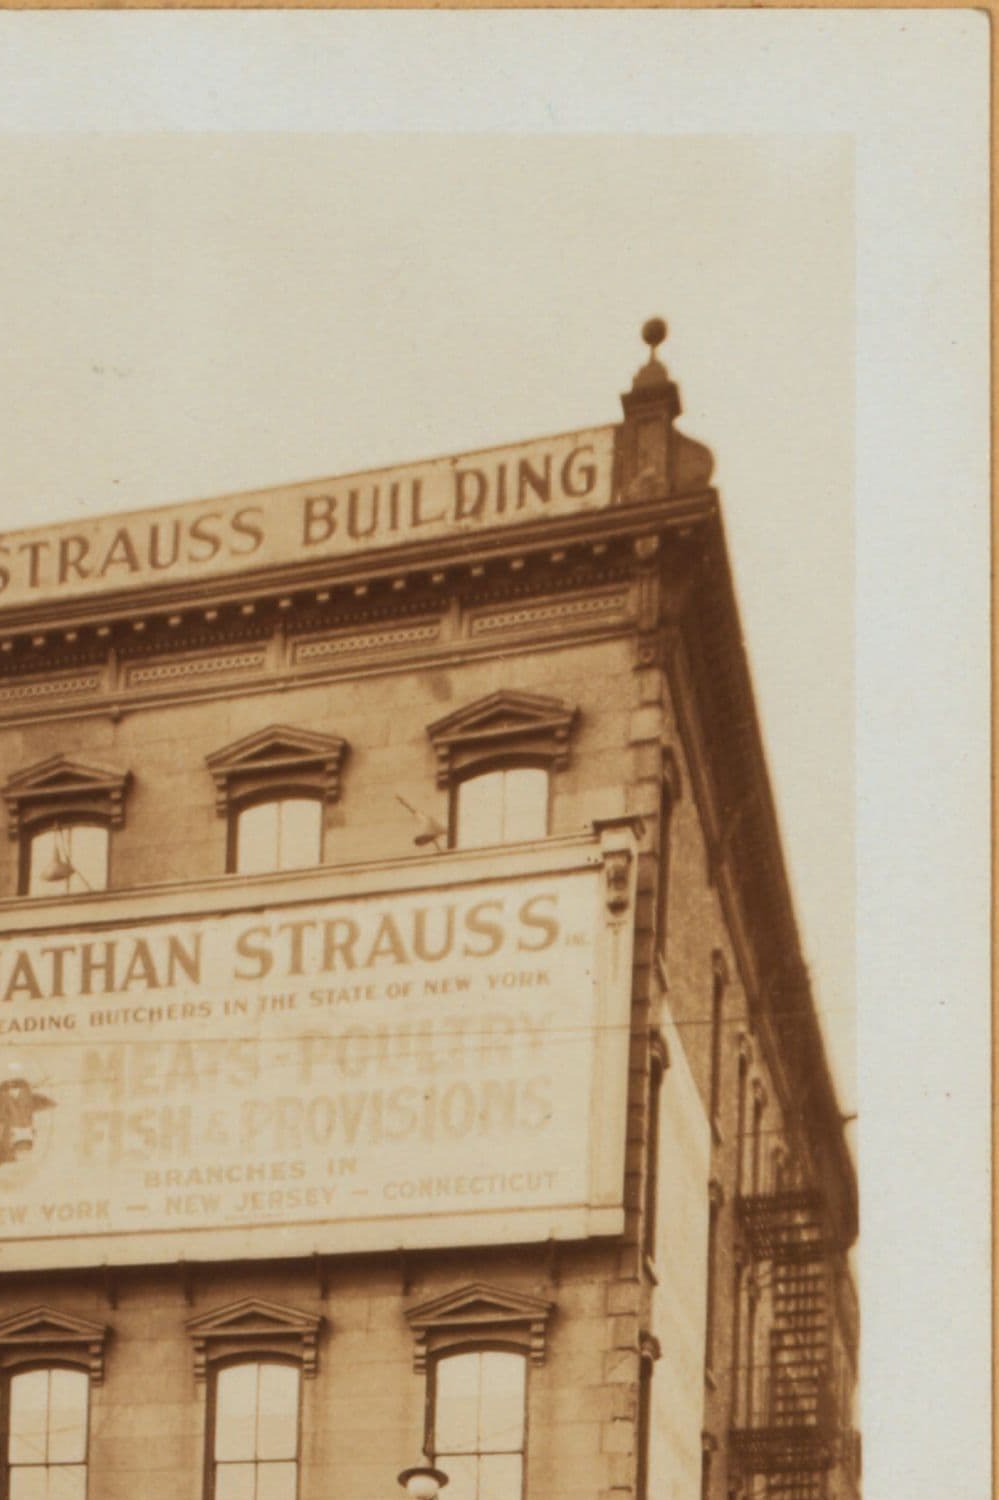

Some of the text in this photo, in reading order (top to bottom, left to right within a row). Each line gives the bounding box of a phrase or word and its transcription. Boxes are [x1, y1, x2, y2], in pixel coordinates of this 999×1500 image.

[302, 444, 599, 547] BUILDING
[233, 896, 560, 981] STRAUSS
[89, 1001, 212, 1028] BUTCHERS
[222, 998, 248, 1017] IN
[257, 992, 297, 1014] THE
[309, 984, 376, 1009] STATE
[386, 980, 413, 999] OF
[424, 976, 472, 996] NEW
[487, 969, 552, 990] YORK
[80, 1035, 260, 1100] MEATS
[80, 1104, 193, 1164] FISH
[242, 1074, 553, 1148] PROVISIONS
[40, 1198, 111, 1222] YORK
[165, 1193, 222, 1216] NEW
[234, 1186, 337, 1212] JERSEY
[382, 1171, 559, 1201] CONNECTICUT
[143, 1157, 359, 1189] BRANCHES IN
